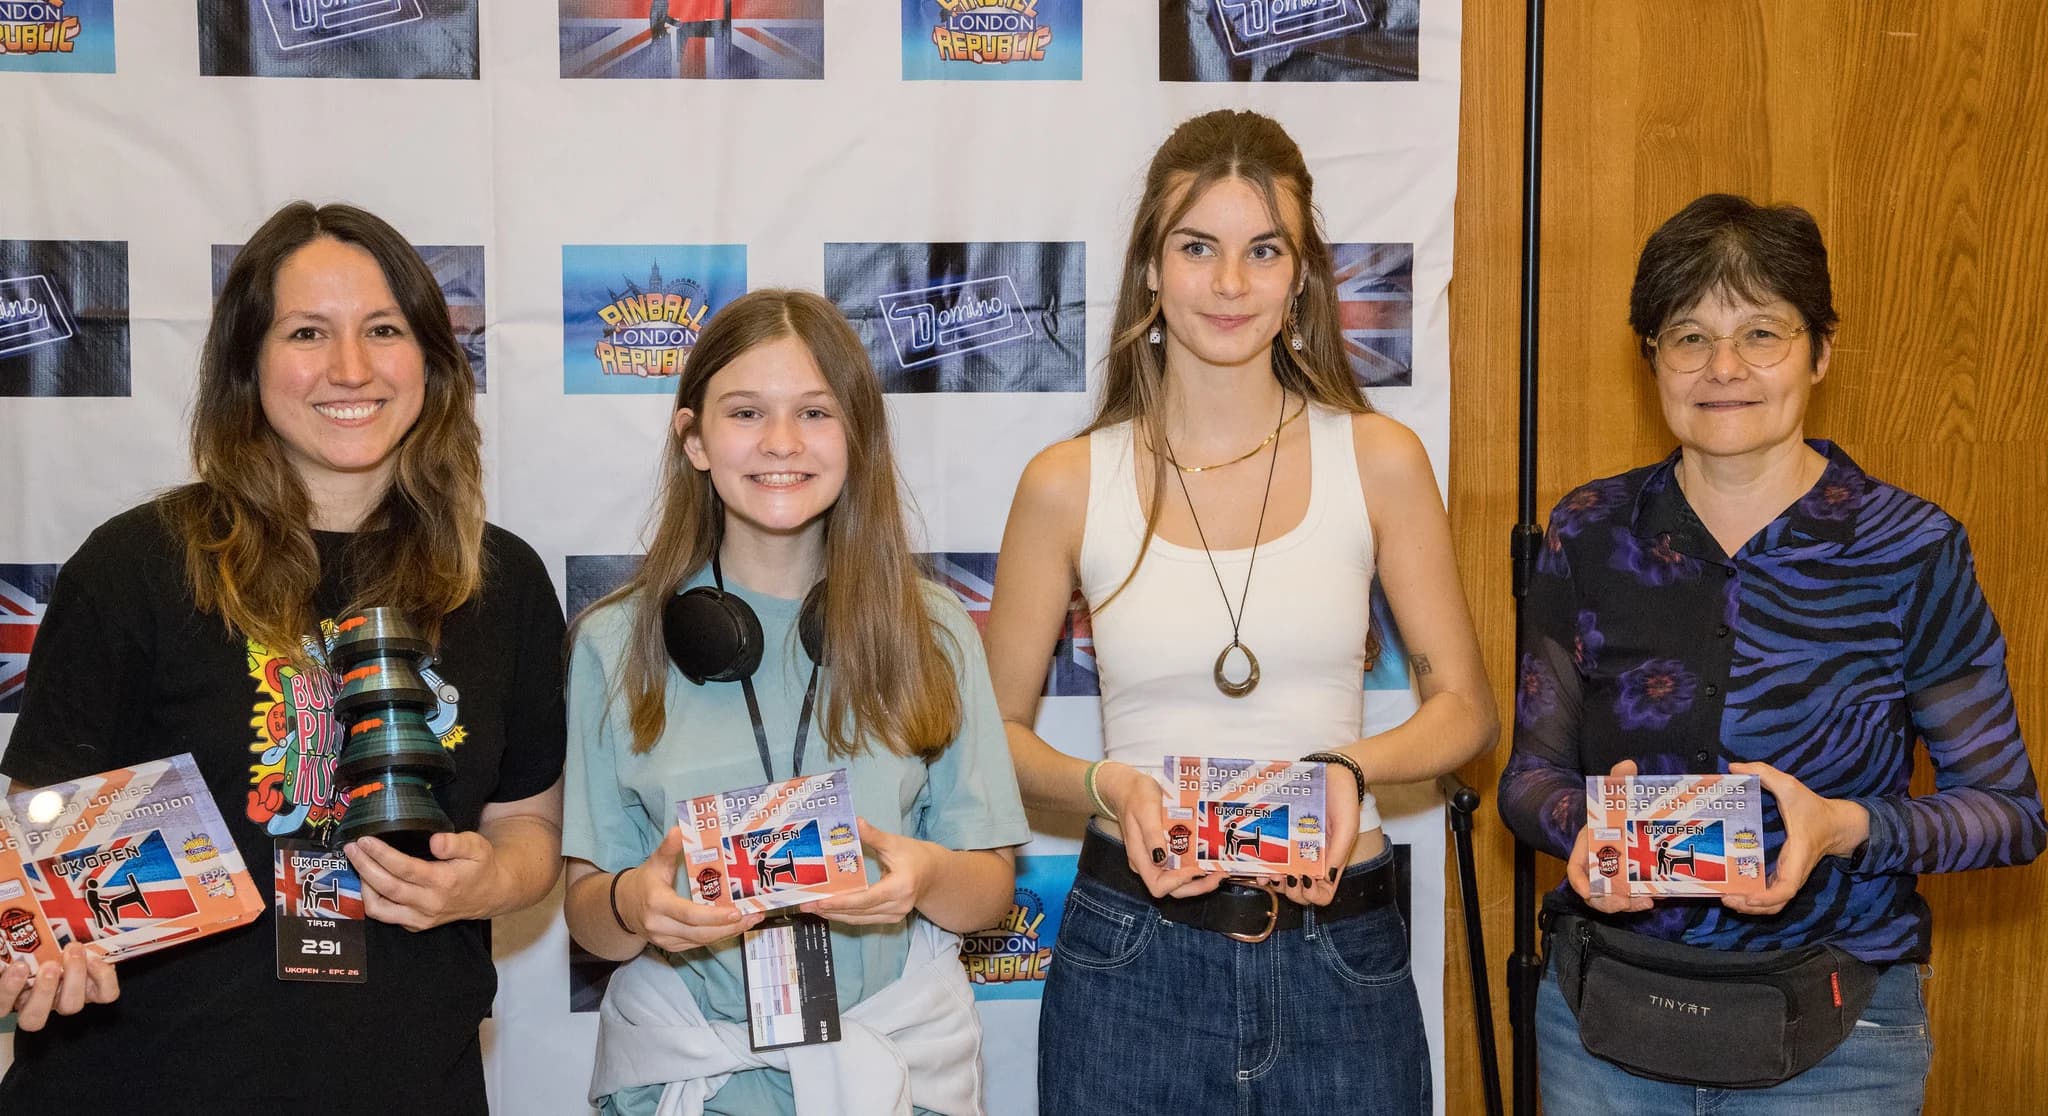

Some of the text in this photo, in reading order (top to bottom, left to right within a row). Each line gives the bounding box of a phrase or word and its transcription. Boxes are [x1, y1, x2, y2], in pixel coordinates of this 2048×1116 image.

[950, 14, 1034, 31] LONDON
[0, 16, 79, 53] UBLIC
[933, 25, 1051, 62] REPUBLIC
[0, 296, 37, 319] ino
[598, 292, 709, 332] PINBALL
[889, 296, 1002, 339] Domino
[613, 329, 699, 345] LONDON
[596, 341, 690, 376] REPUBL
[1179, 765, 1312, 782] UK Open Ladies
[87, 785, 153, 809] Ladies
[1179, 780, 1312, 796] 2026 3rd Place
[1603, 784, 1745, 799] UK Open Ladies
[693, 779, 835, 816] UK Open Ladies
[1604, 799, 1745, 811] 2026 4th Place
[26, 818, 90, 845] Grand
[95, 794, 195, 827] Champion
[694, 795, 838, 832] 2026 2nd Place
[1215, 806, 1271, 818] UK OPEN
[740, 829, 800, 849] UK OPEN
[1644, 825, 1705, 836] UK OPEN
[54, 845, 141, 877] UK OPEN
[291, 857, 347, 871] UK OPEN
[307, 920, 336, 928] TIRZA
[301, 939, 341, 955] 291
[961, 937, 1036, 952] ONDON
[329, 968, 345, 976] EPC
[959, 947, 1052, 983] PUBLIC
